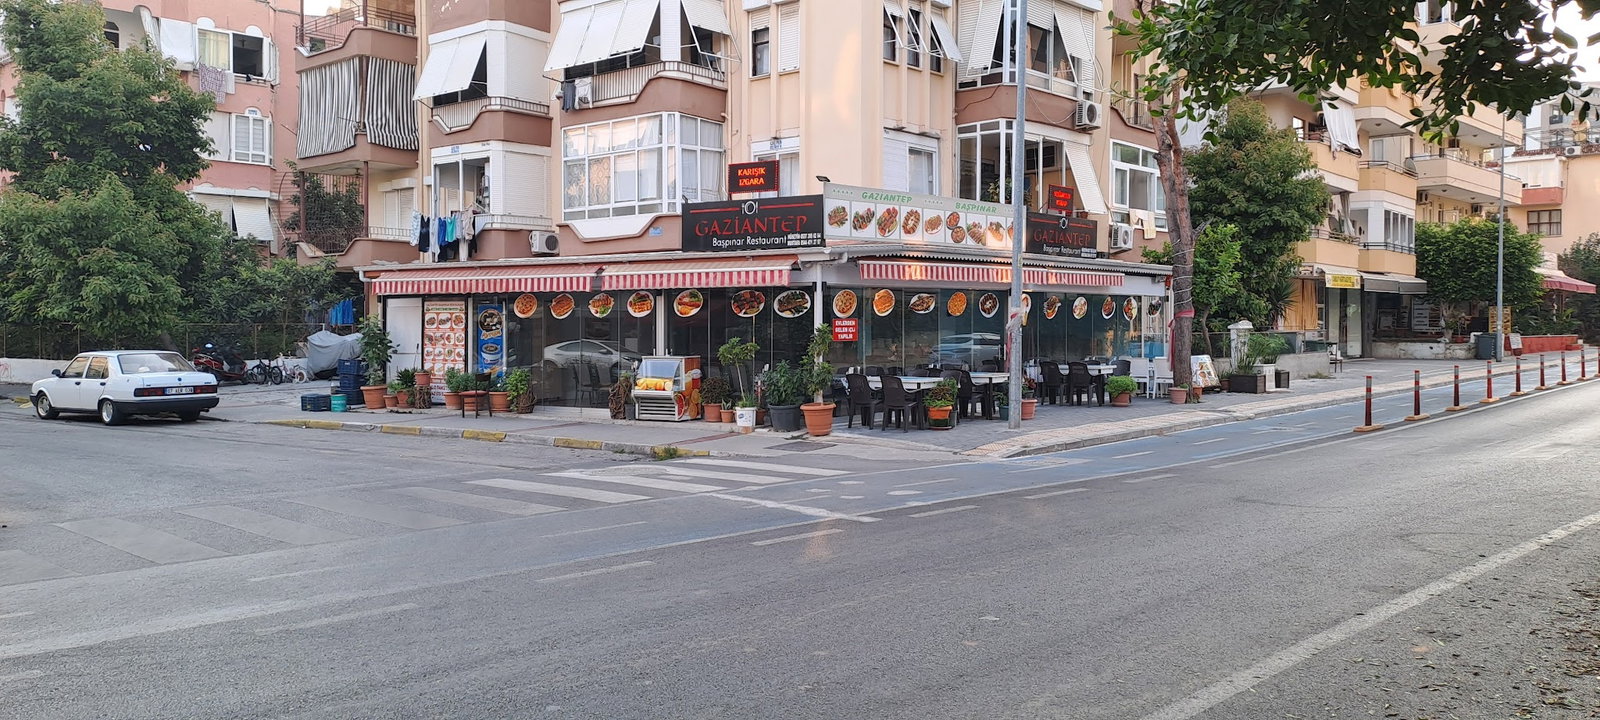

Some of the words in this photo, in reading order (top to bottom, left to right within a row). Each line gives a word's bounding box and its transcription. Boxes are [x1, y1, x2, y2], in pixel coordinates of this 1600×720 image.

[738, 167, 766, 177] KARIŞIK
[739, 178, 765, 186] IZGARA
[861, 191, 913, 203] GAZİANTEP
[695, 216, 808, 237] GAZİANTEP
[712, 236, 744, 248] Başpınar
[746, 236, 787, 245] Restaurant
